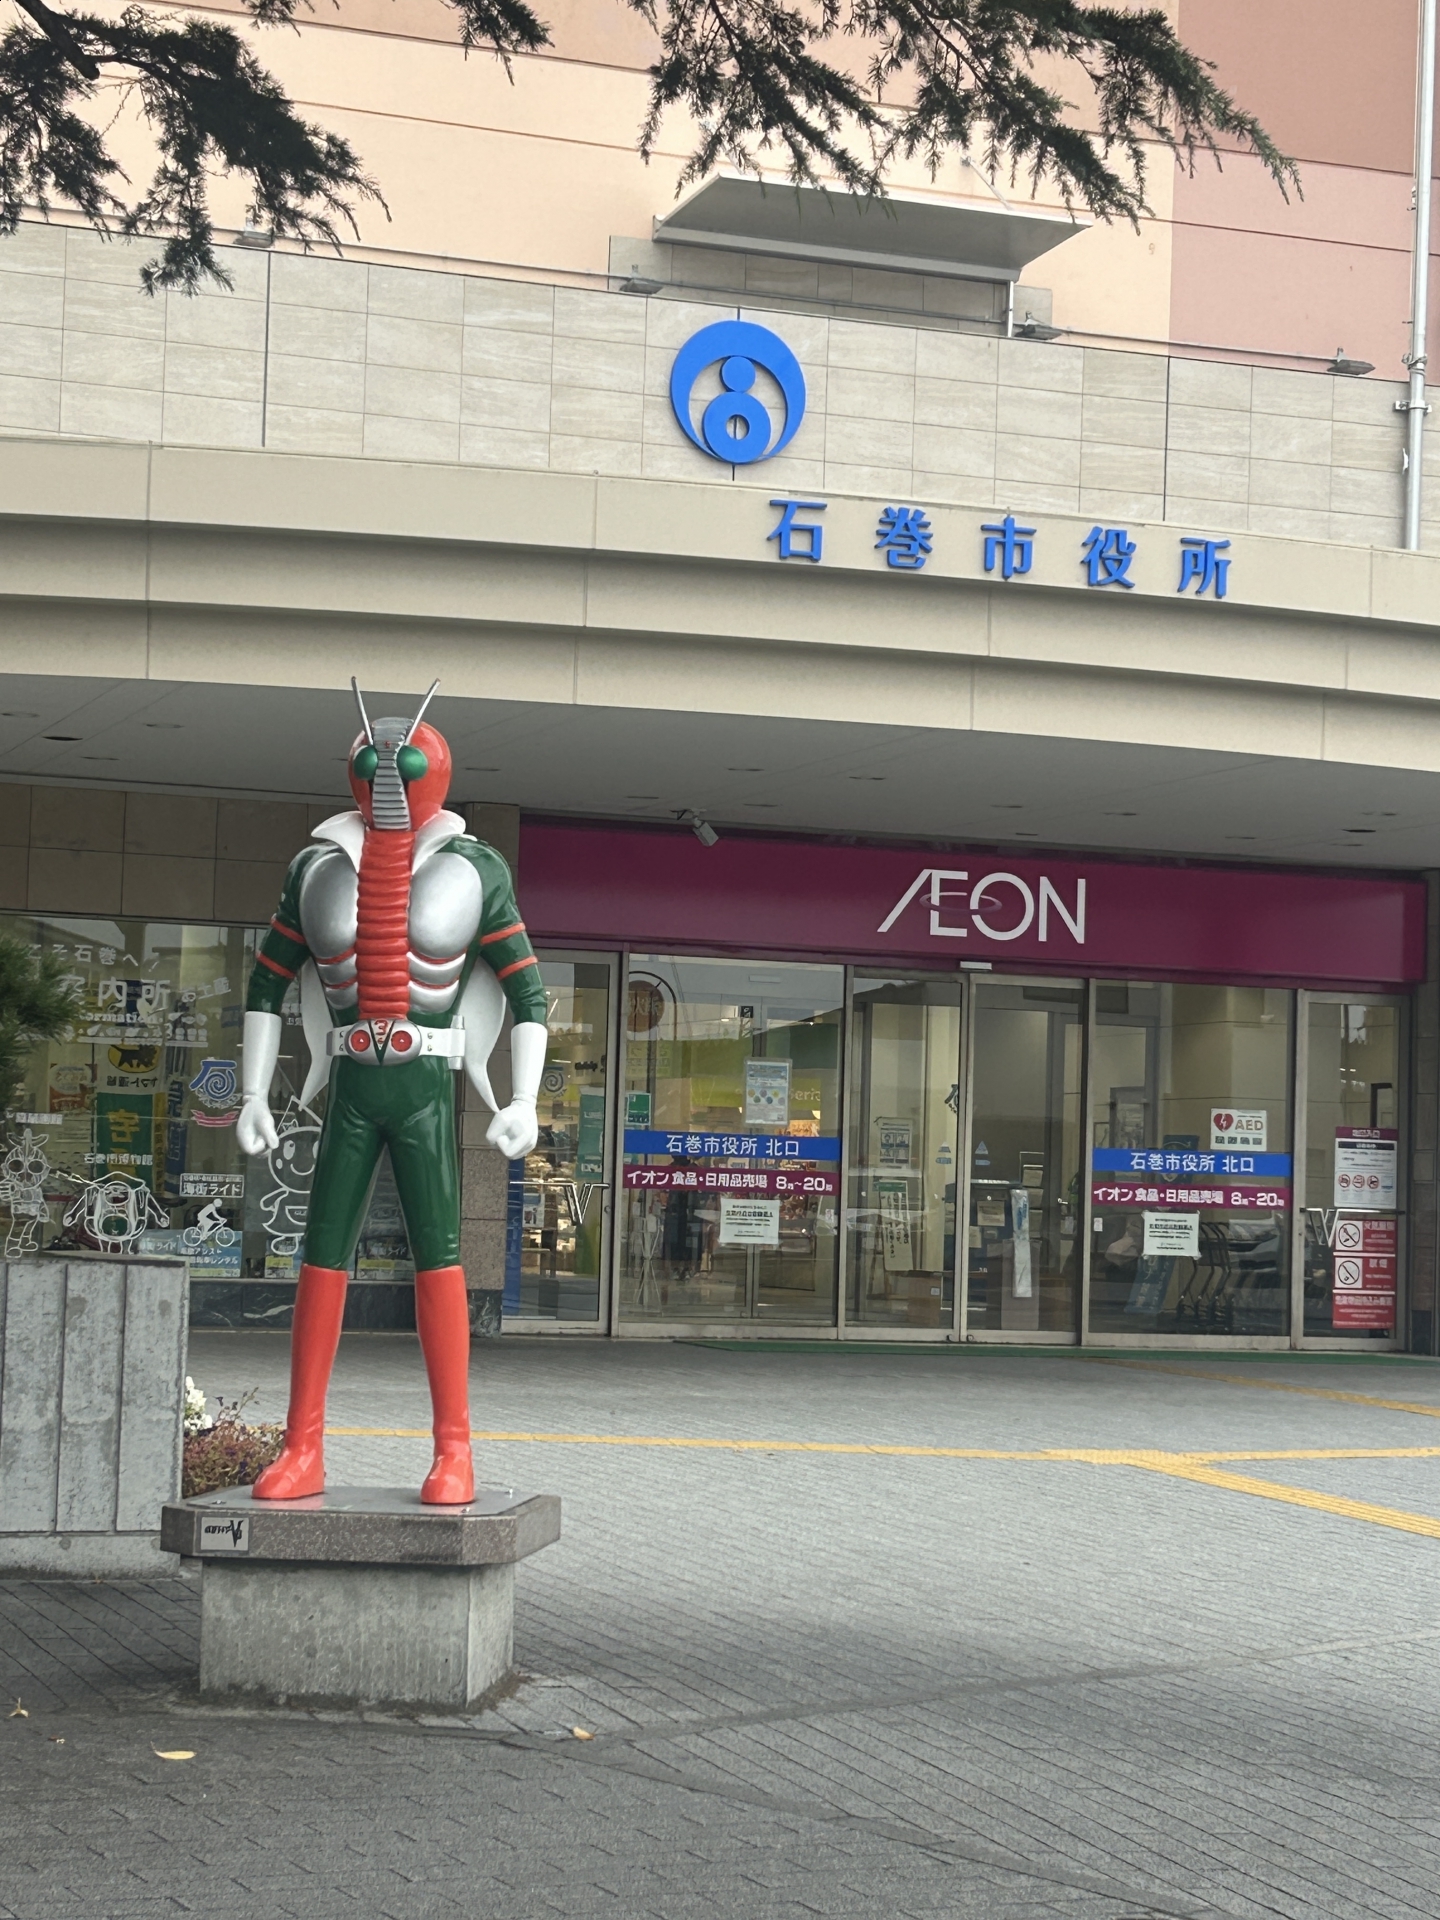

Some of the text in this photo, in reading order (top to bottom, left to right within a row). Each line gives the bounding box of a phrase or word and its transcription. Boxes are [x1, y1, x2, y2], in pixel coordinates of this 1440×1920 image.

[767, 499, 1231, 599] 石巻市役所
[877, 868, 1086, 944] AEON
[1235, 1118, 1264, 1131] AED
[665, 1135, 800, 1157] 石巻市役所 北口
[1130, 1152, 1254, 1173] 石巻市役所 北口
